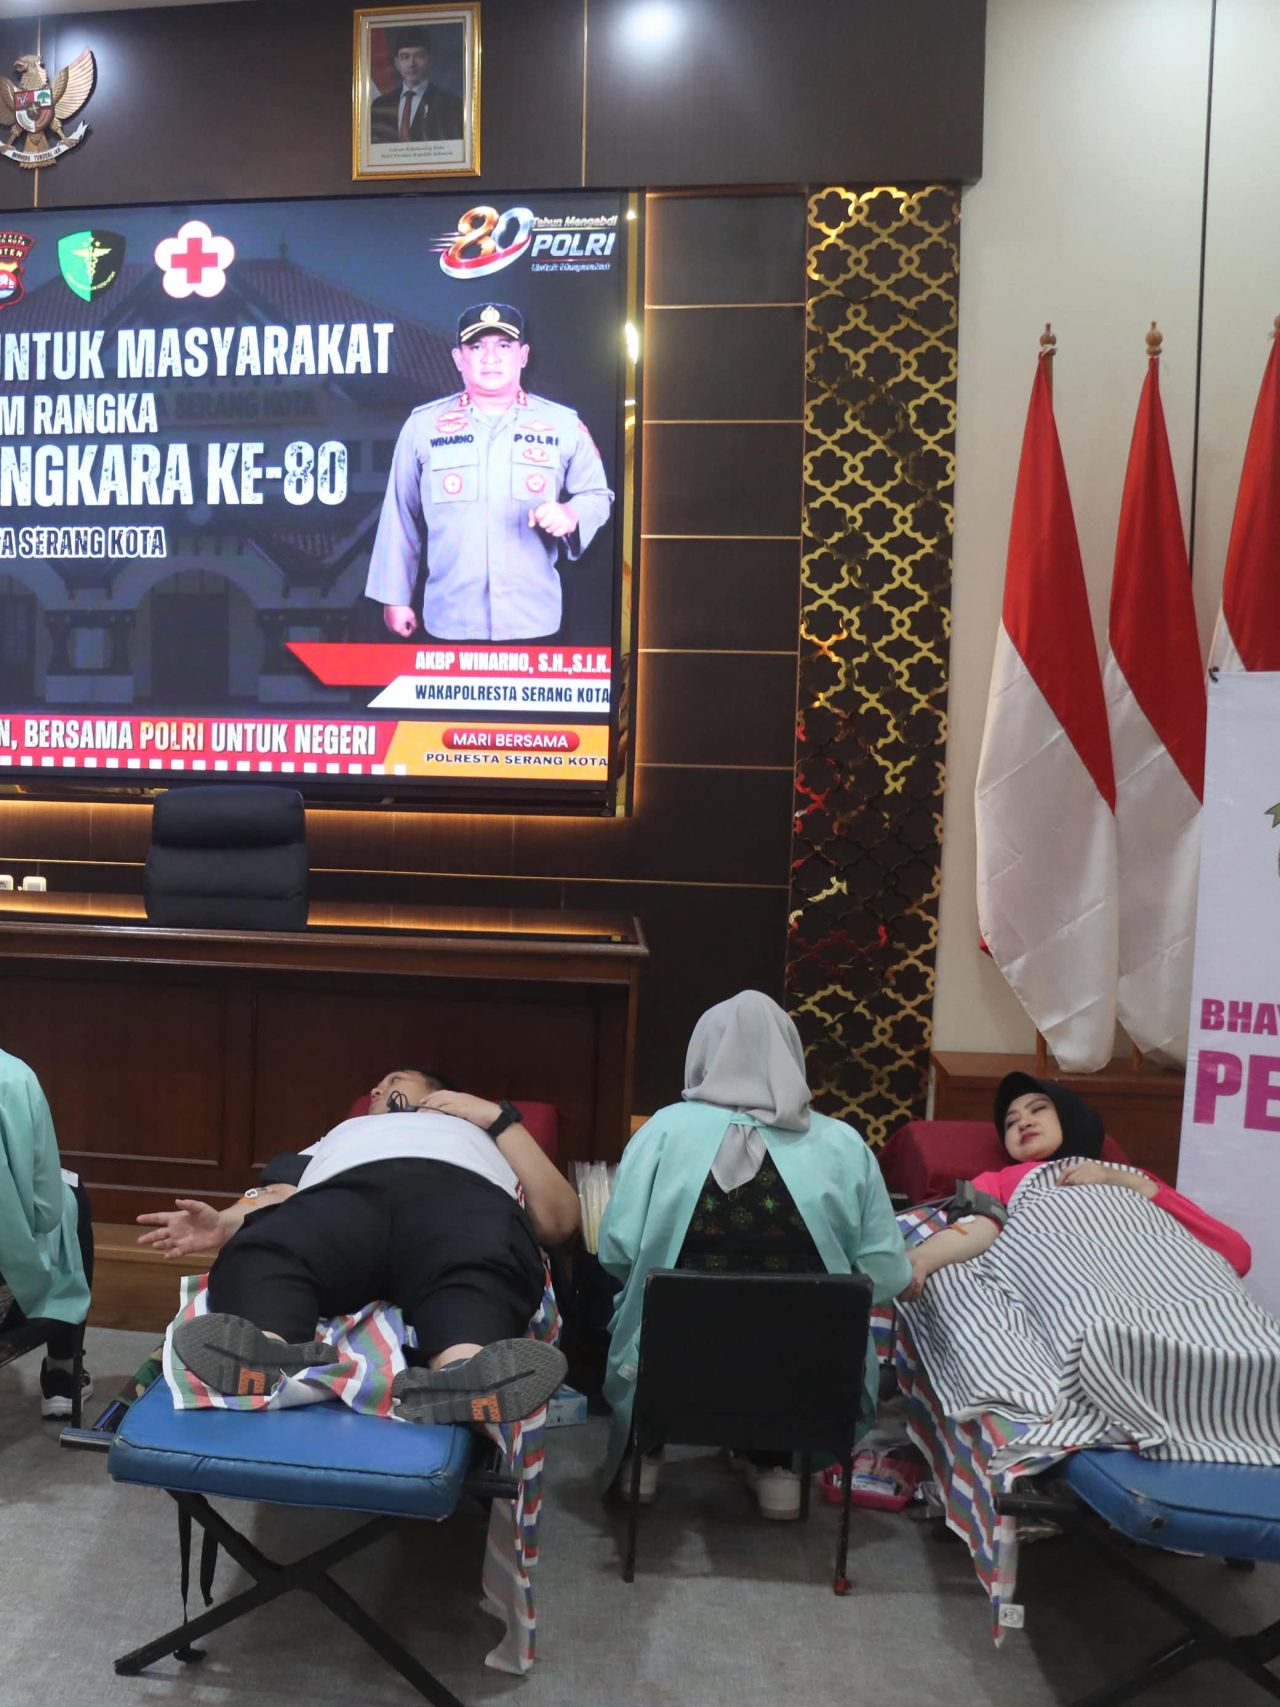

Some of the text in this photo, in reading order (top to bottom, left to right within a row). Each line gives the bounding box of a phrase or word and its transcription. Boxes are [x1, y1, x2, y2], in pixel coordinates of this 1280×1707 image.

[447, 205, 534, 260] 80
[532, 214, 619, 228] Tahun Mengabdi
[531, 232, 616, 257] POLRI
[116, 322, 395, 377] MASYARAKAT
[33, 391, 159, 436] RANGKA
[513, 433, 559, 447] POLRI
[206, 440, 349, 507] KE-80
[18, 525, 106, 559] SERANG
[108, 524, 168, 558] KOTA
[415, 651, 456, 671] AKBP
[458, 651, 534, 674] WINARNO,
[415, 684, 610, 704] WAKAPOLRESTA SERANG KOTA
[24, 719, 133, 750] BERSAMA
[139, 721, 205, 751] POLRI
[210, 722, 289, 754] UNTUK
[294, 724, 377, 756] NEGERI
[452, 733, 569, 749] MARI BERSAMA
[425, 752, 609, 767] POLRESTA SERANG KOTA
[1200, 998, 1280, 1036] BHA
